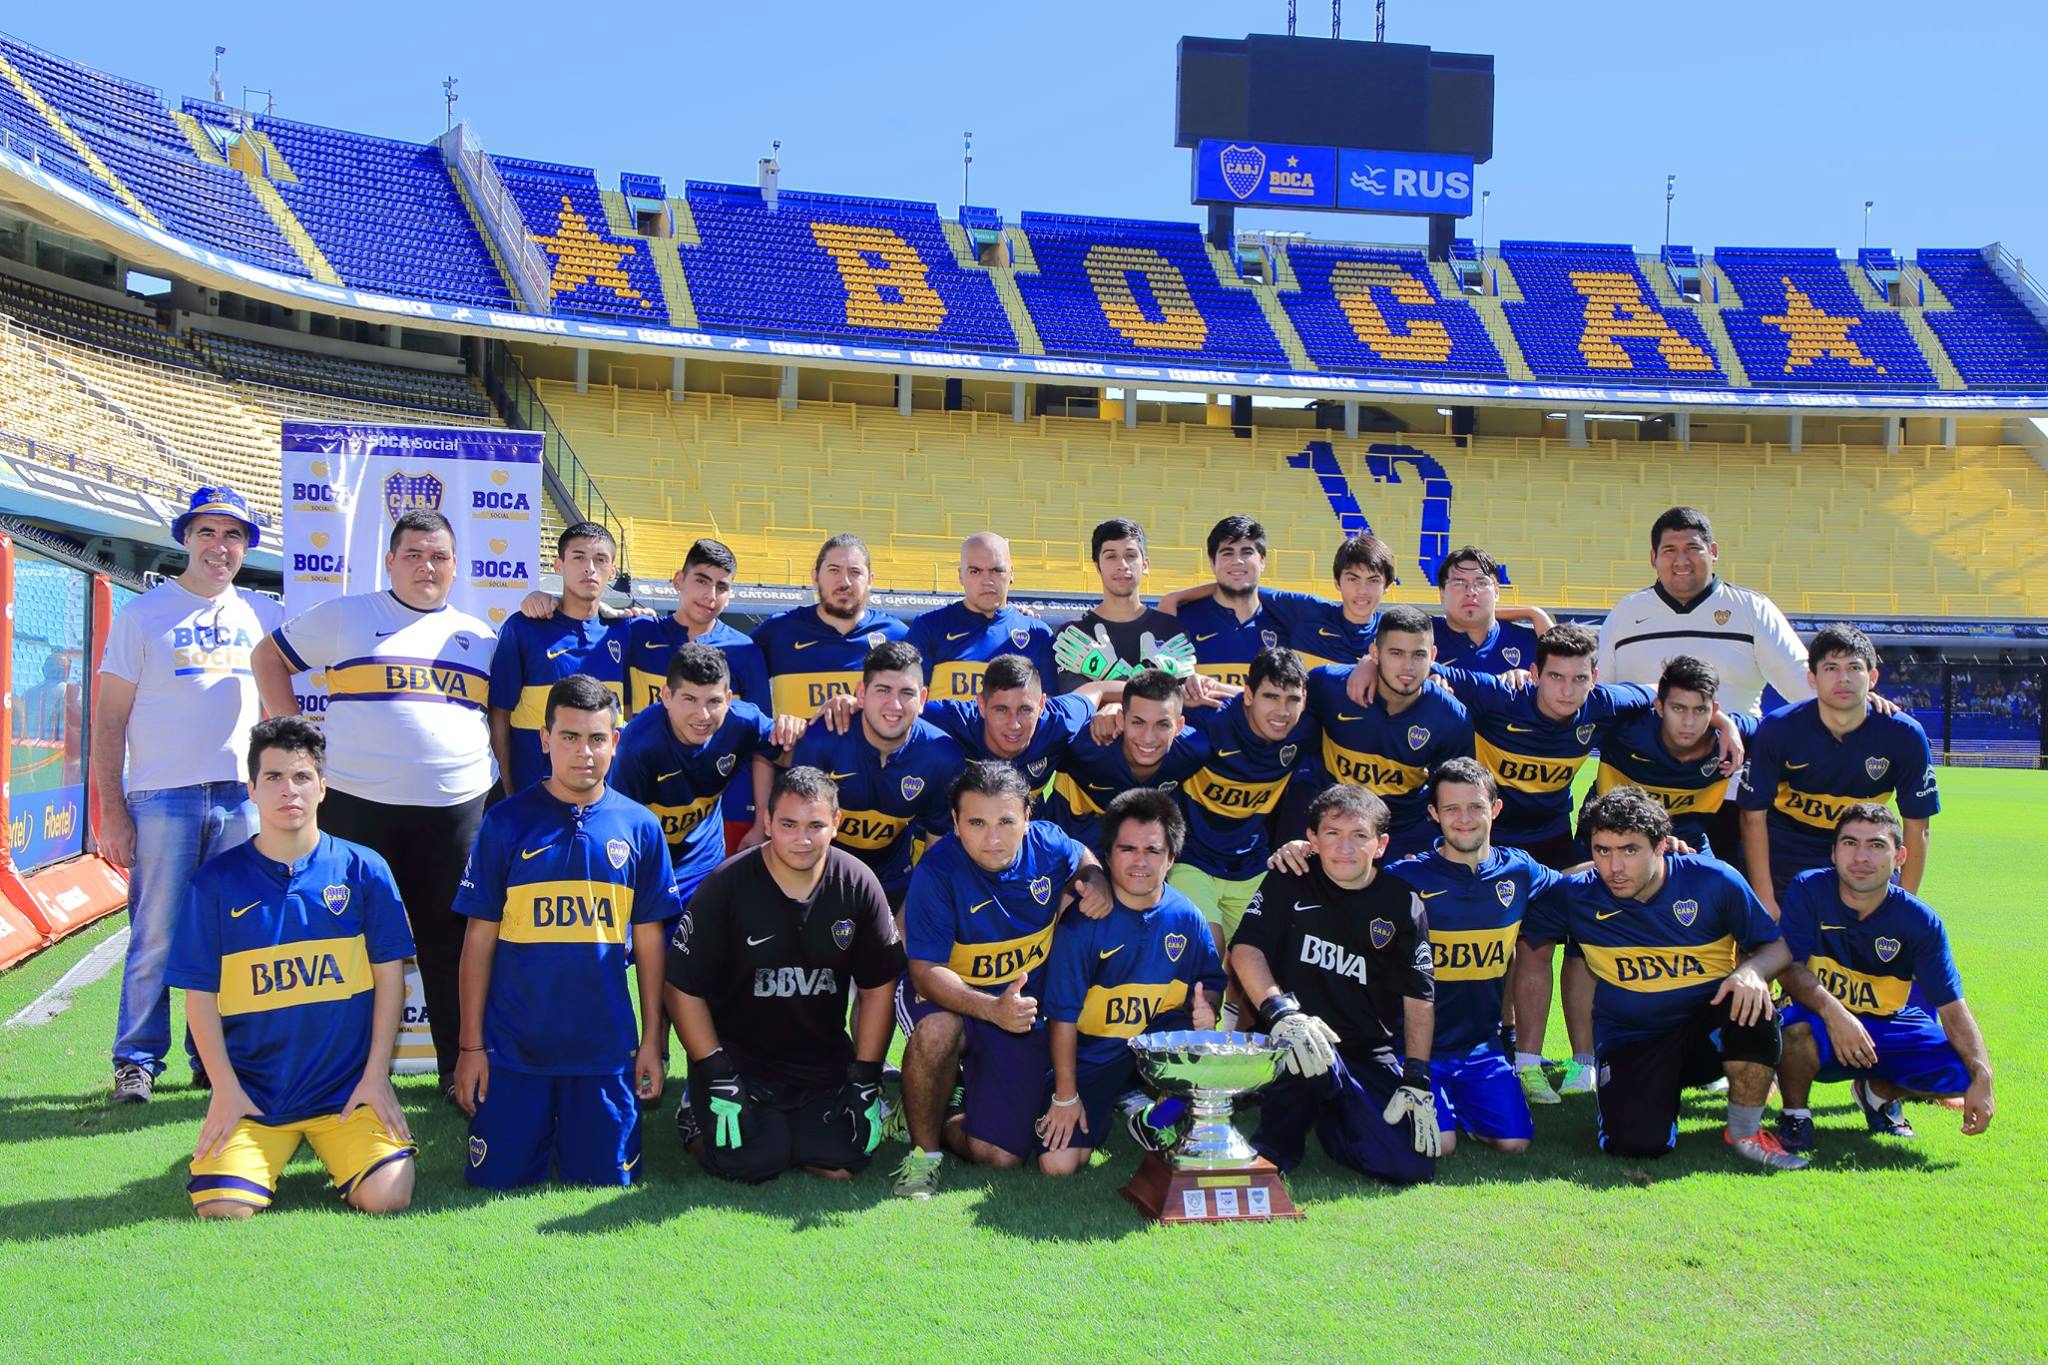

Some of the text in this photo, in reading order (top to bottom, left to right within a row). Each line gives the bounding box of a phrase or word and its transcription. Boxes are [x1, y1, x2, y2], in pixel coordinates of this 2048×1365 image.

[1269, 171, 1315, 187] BOCA
[1393, 168, 1470, 199] RUS
[909, 351, 982, 368] ISENBECK
[1034, 359, 1105, 376] ISENBECK
[1168, 367, 1239, 384] ISENBECK
[1289, 374, 1359, 389] ISENBECK
[1419, 381, 1491, 396] ISENBECK
[1538, 386, 1609, 400] ISENBECK
[414, 436, 458, 451] Social
[389, 493, 437, 510] CABJ
[472, 490, 530, 510] BOCA
[471, 560, 529, 579] BOCA
[738, 590, 803, 601] GATORADE
[385, 665, 467, 697] BBVA
[1335, 754, 1404, 786] BBVA
[1499, 759, 1574, 785] BBVA
[1203, 783, 1273, 808] BBVA
[839, 816, 895, 841] BVA
[533, 896, 614, 928] BBVA
[971, 942, 1045, 979] BBVA
[1300, 934, 1367, 985] BBVA
[1431, 940, 1505, 968] BBVA
[250, 954, 345, 996] BBVA
[1615, 953, 1707, 982] BBVA
[754, 967, 838, 998] BBVA
